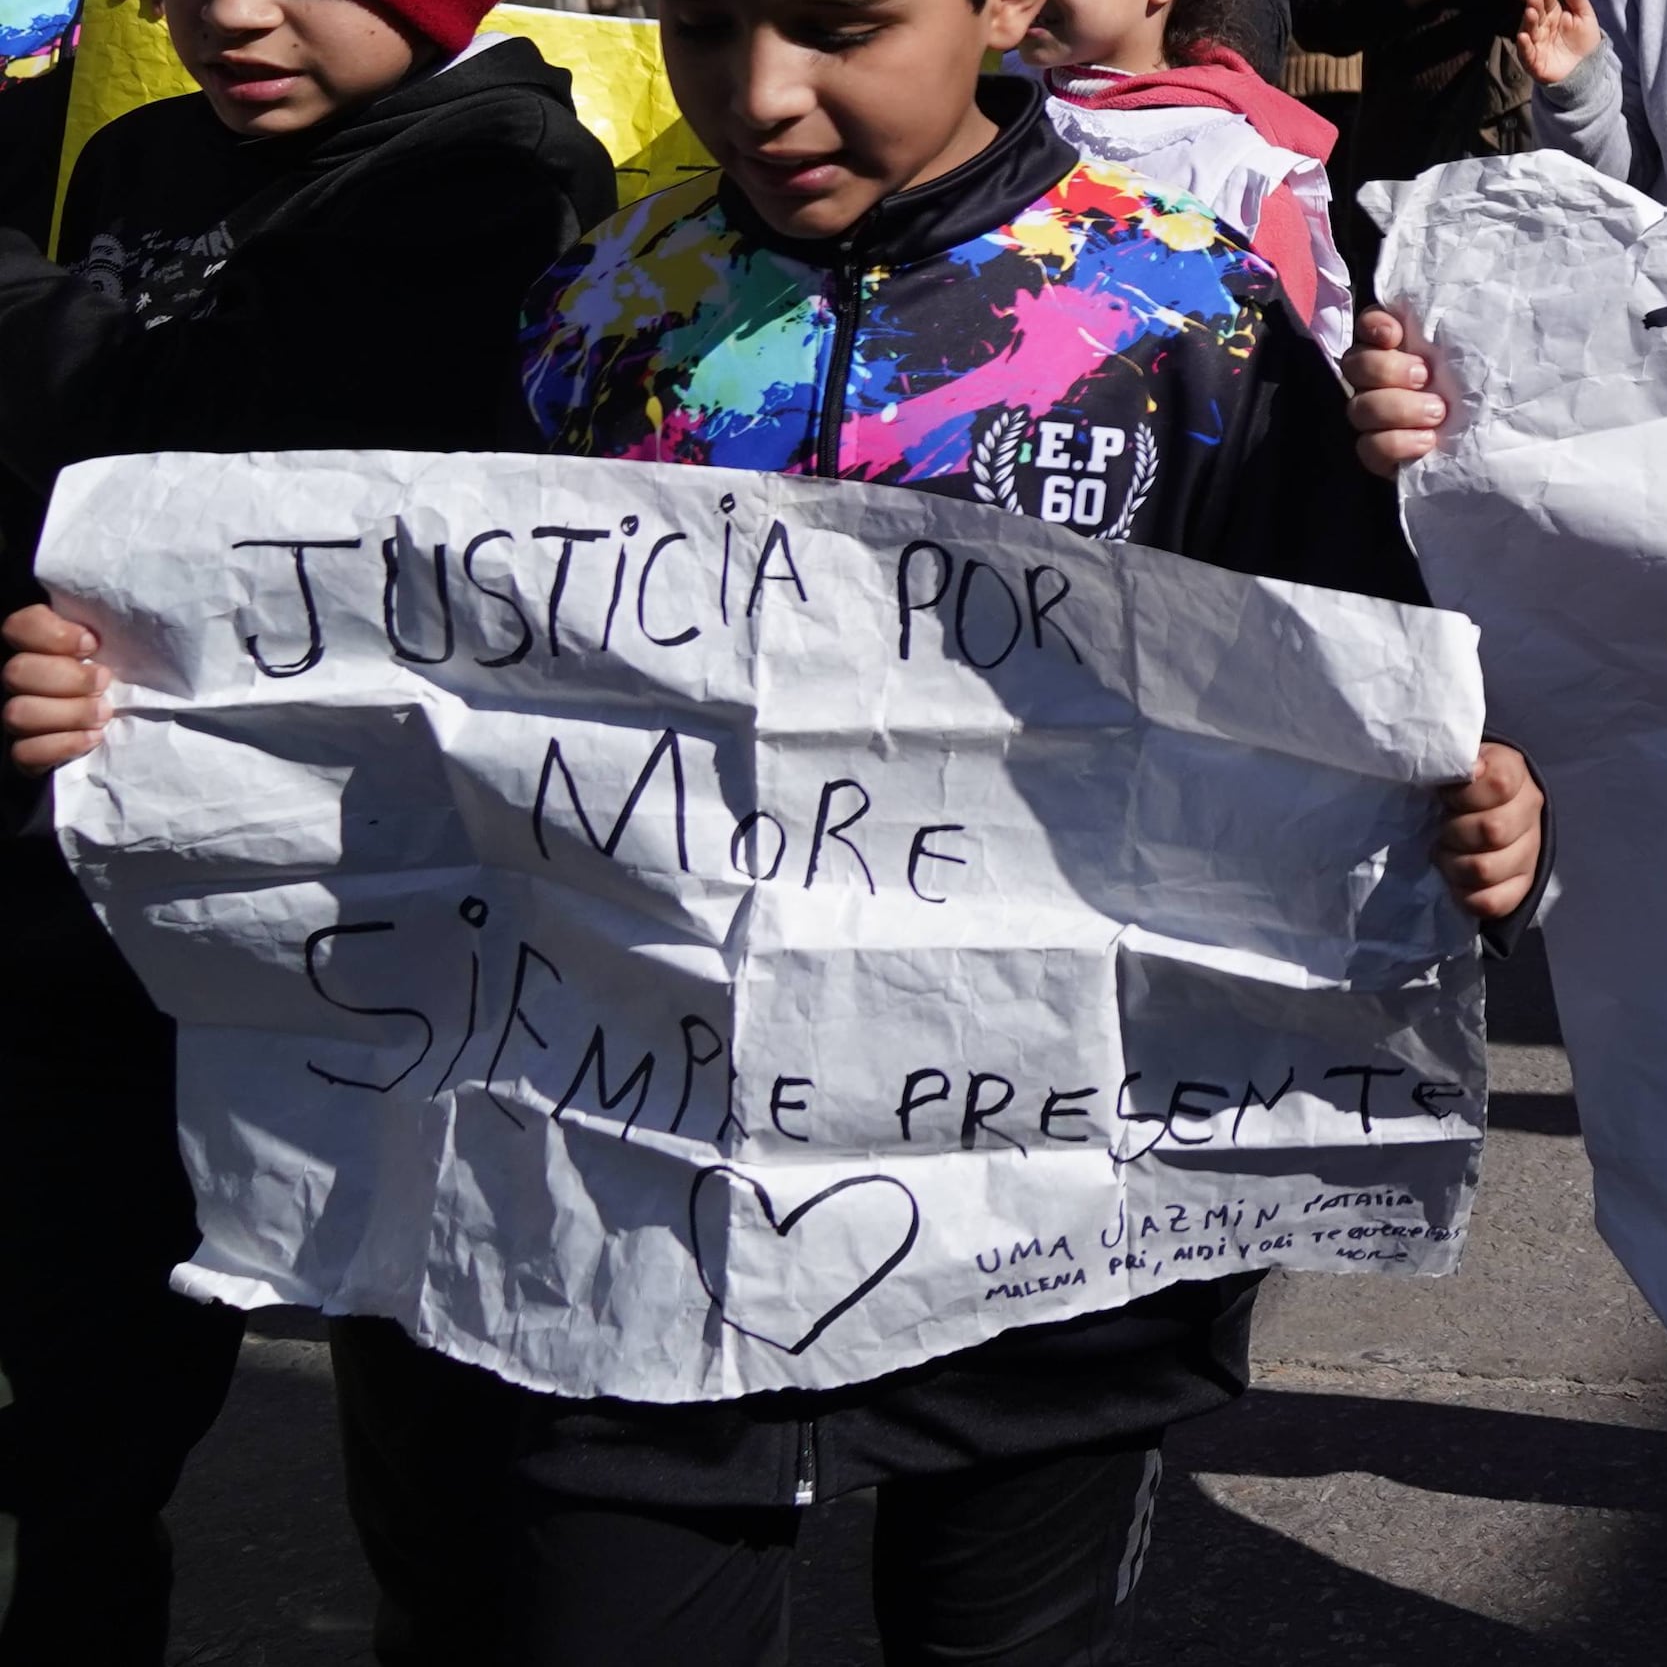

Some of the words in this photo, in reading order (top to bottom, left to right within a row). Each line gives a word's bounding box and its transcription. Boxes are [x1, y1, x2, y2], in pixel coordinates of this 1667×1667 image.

[1035, 420, 1126, 473] E.P
[1041, 474, 1108, 526] 60
[897, 539, 1083, 670] POR
[894, 1065, 1465, 1166] PRESENTE
[976, 1240, 1074, 1275] UMA
[985, 1268, 1087, 1301] MALENA
